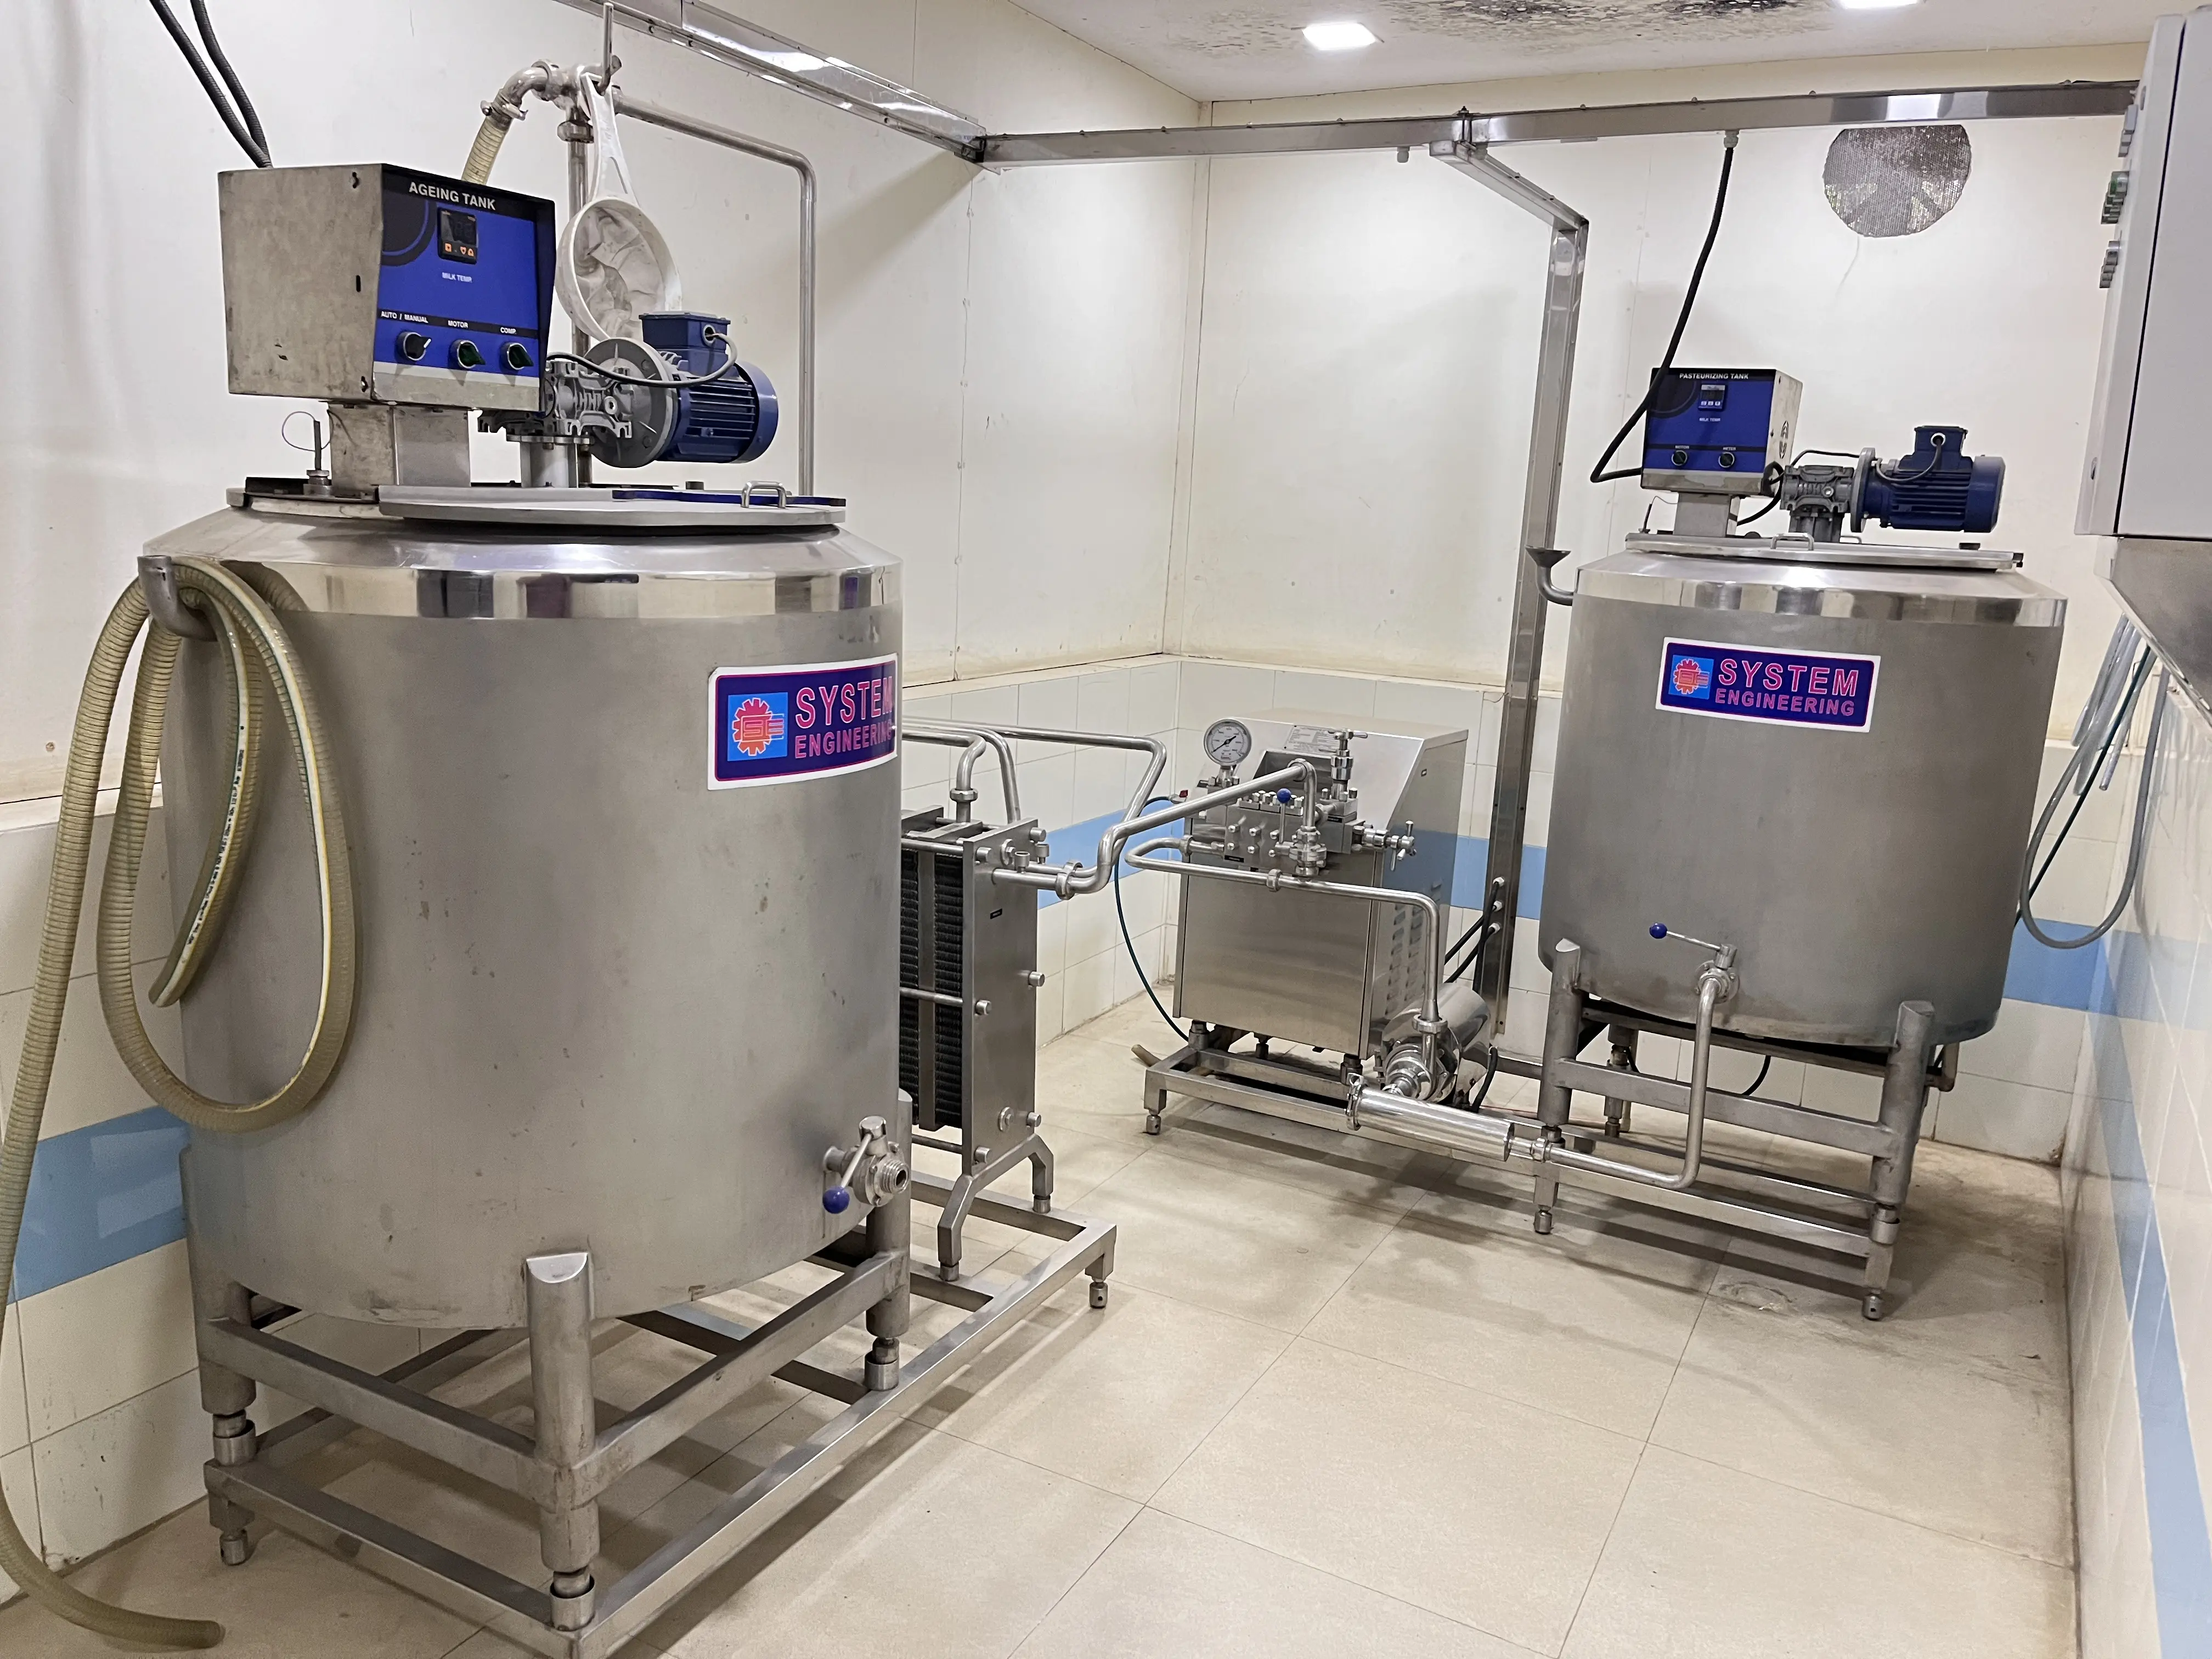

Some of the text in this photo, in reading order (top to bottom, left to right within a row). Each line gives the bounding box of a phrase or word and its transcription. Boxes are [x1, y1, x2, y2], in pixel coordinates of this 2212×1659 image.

[409, 182, 496, 211] AGEING TANK
[442, 272, 456, 281] MILK
[381, 311, 397, 319] AUTO
[404, 314, 428, 323] MANUAL
[448, 320, 469, 328] MOTOR
[1718, 658, 1859, 697] SYSTEM
[795, 675, 893, 729] SYSTEM
[1715, 688, 1855, 716] ENGINEERING
[794, 723, 893, 759] ENGINEERING
